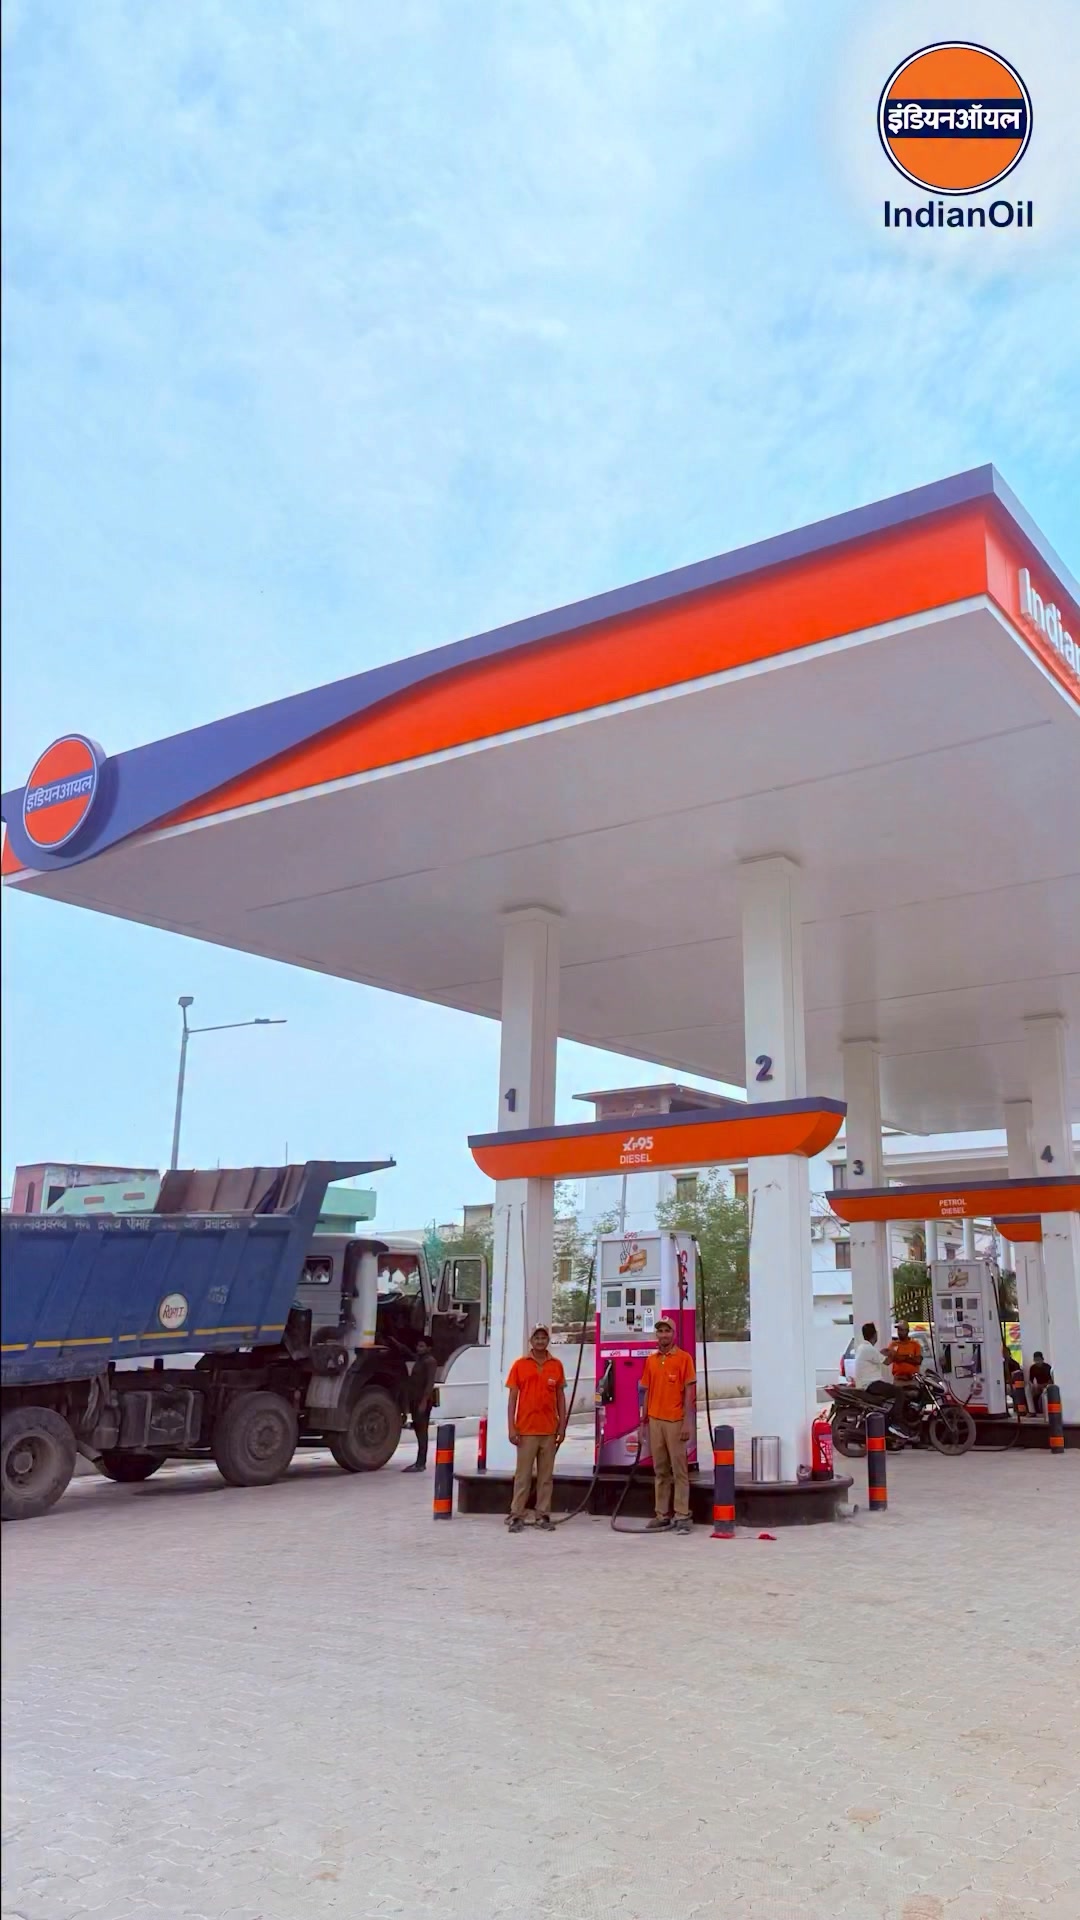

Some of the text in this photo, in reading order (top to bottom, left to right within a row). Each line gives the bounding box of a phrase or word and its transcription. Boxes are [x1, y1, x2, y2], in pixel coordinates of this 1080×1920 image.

[755, 1055, 773, 1081] 2
[505, 1088, 517, 1112] 1
[619, 1153, 652, 1164] DIESEL
[1040, 1145, 1055, 1163] 4
[853, 1159, 865, 1175] 3
[939, 1198, 967, 1206] PETROL
[941, 1206, 966, 1215] DIESEL
